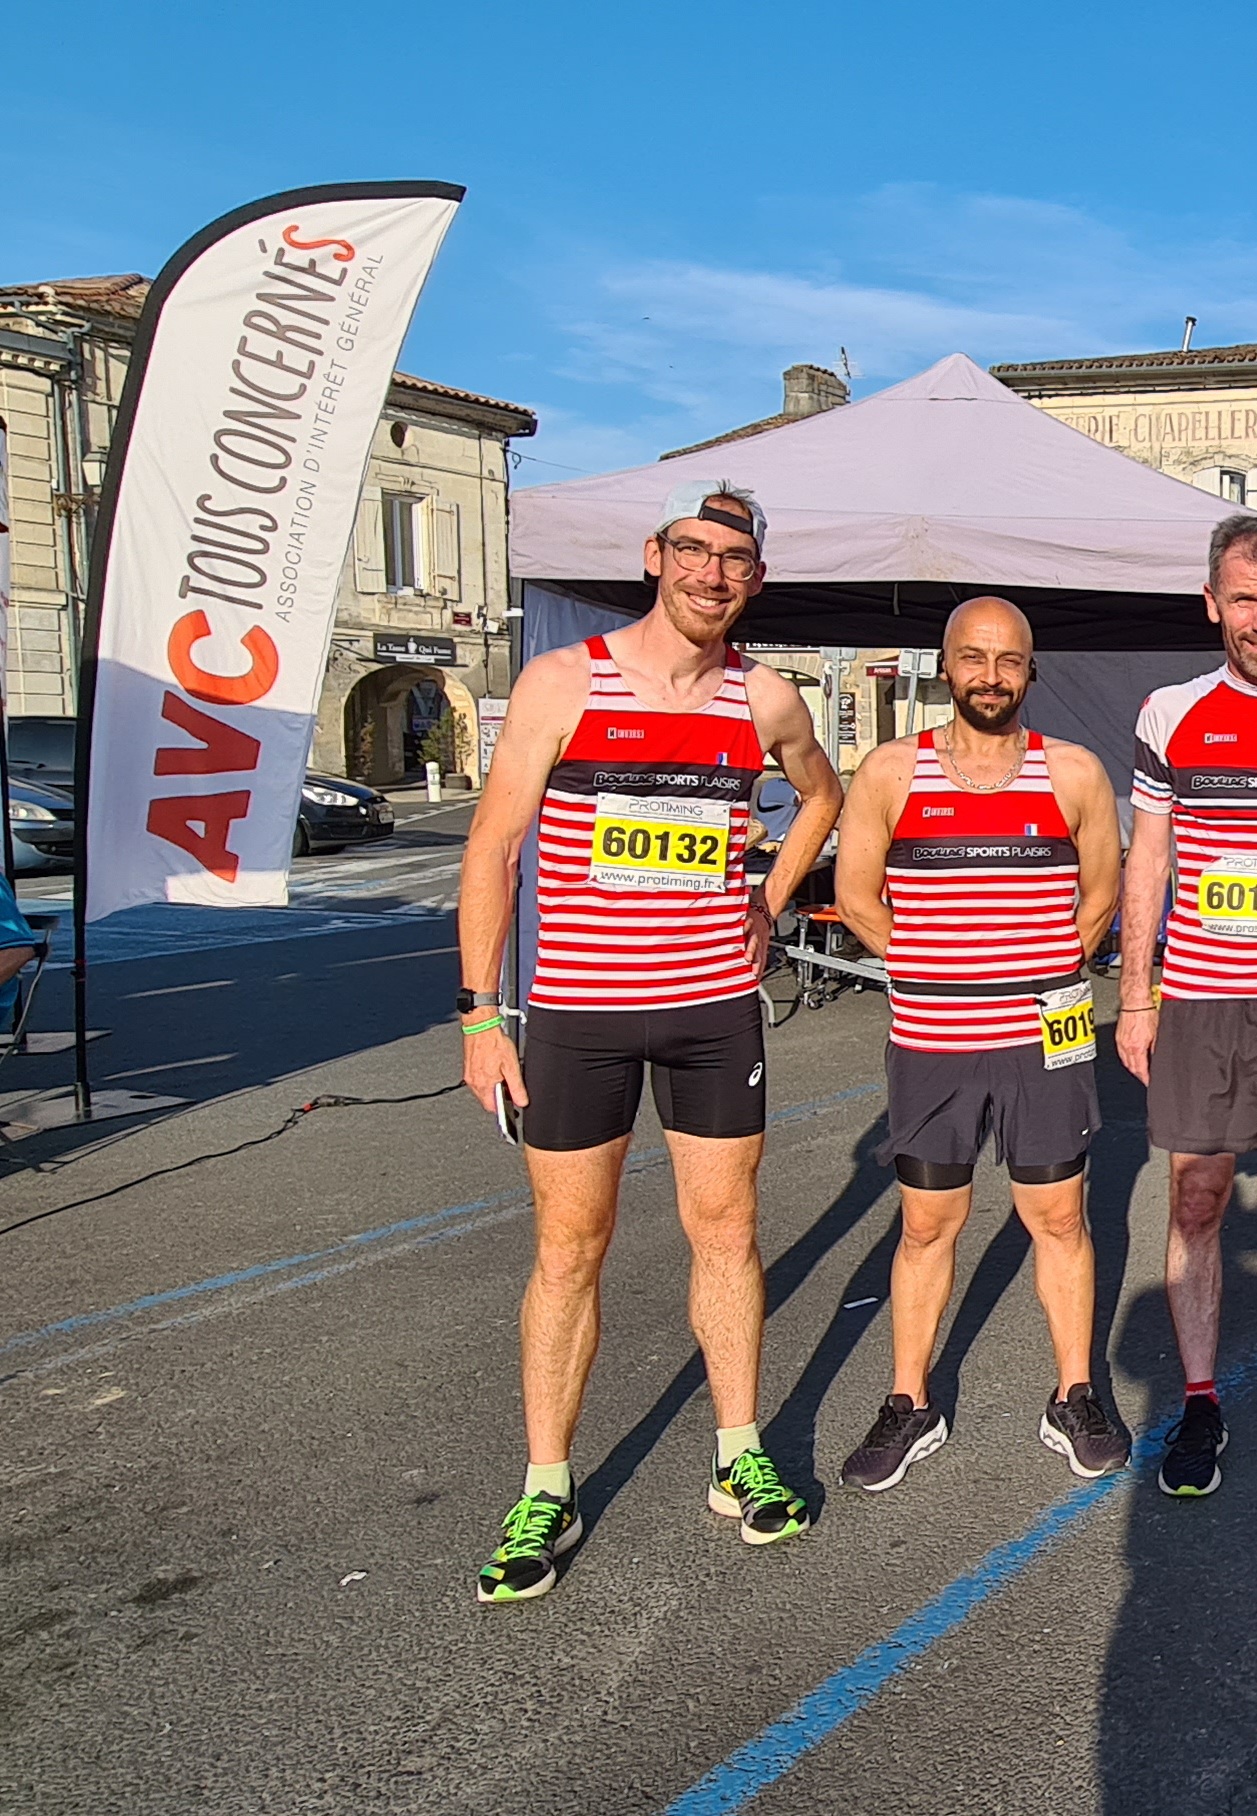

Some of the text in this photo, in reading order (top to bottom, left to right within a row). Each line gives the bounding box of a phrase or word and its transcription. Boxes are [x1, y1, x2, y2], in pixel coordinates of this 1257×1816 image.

[178, 225, 356, 609] TOUS CONCERNÉS
[275, 254, 384, 623] ASSOCIATION D'INTÉRÊT GÉNÉRAL
[146, 608, 279, 884] AVC
[656, 774, 700, 787] SPORTS
[1191, 774, 1248, 790] BOULIAC
[628, 798, 704, 817] PROTIMING
[602, 826, 720, 866] 60132
[912, 846, 1052, 861] BOULIAC SPORTS PLAISIRS
[600, 870, 716, 891] www.protiming.fr
